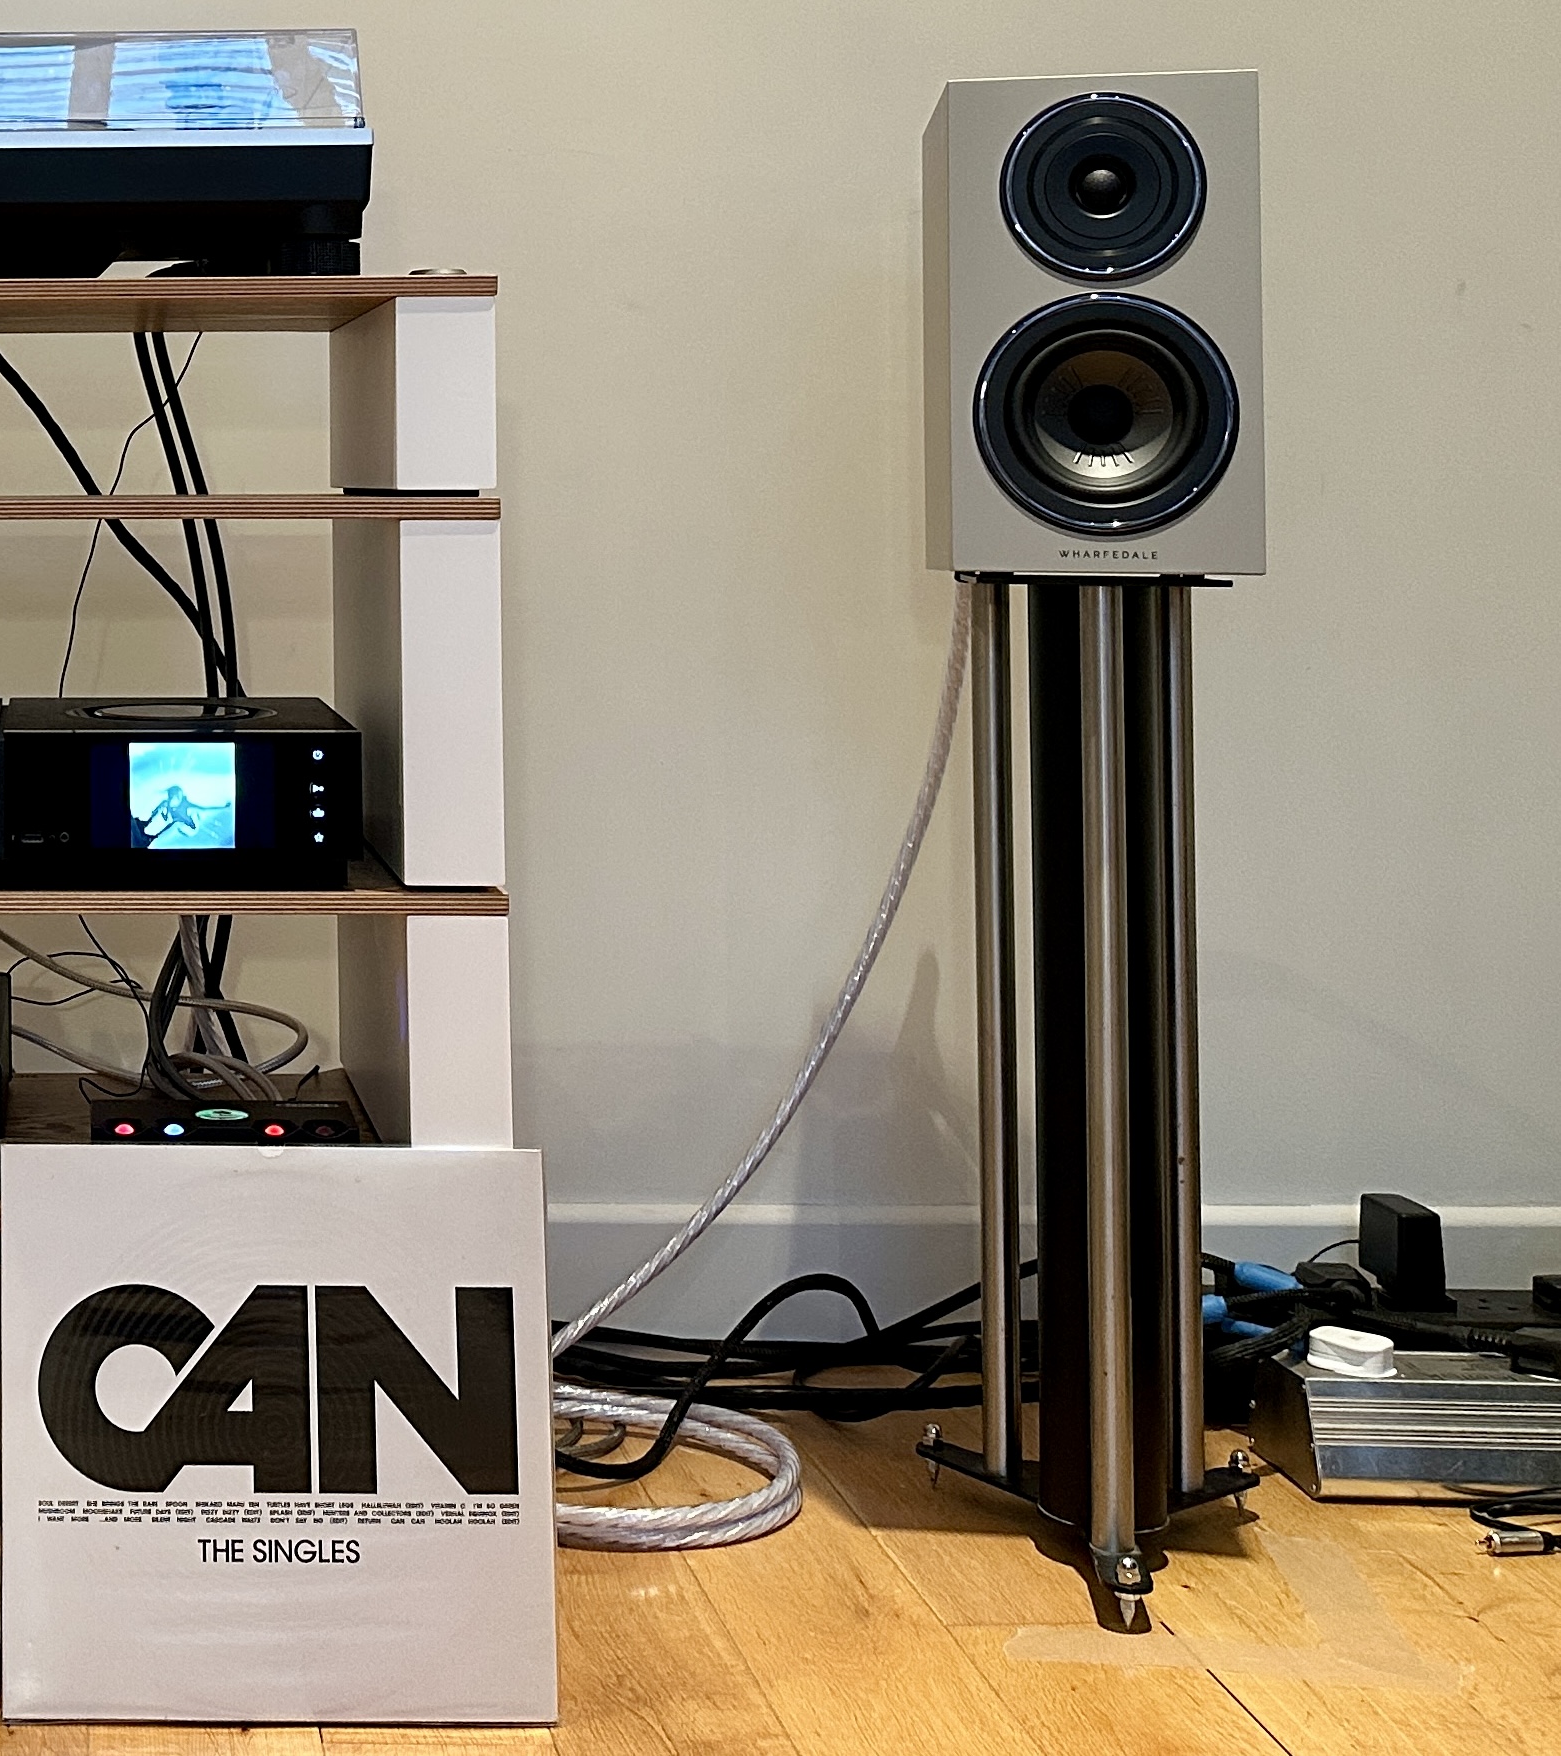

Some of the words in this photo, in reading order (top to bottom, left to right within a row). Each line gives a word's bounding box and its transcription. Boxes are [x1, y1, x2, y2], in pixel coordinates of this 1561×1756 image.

[1059, 549, 1158, 560] WHARFEDALE
[38, 1284, 519, 1495] CAN
[197, 1539, 244, 1563] THE
[252, 1539, 361, 1563] SINGLES
